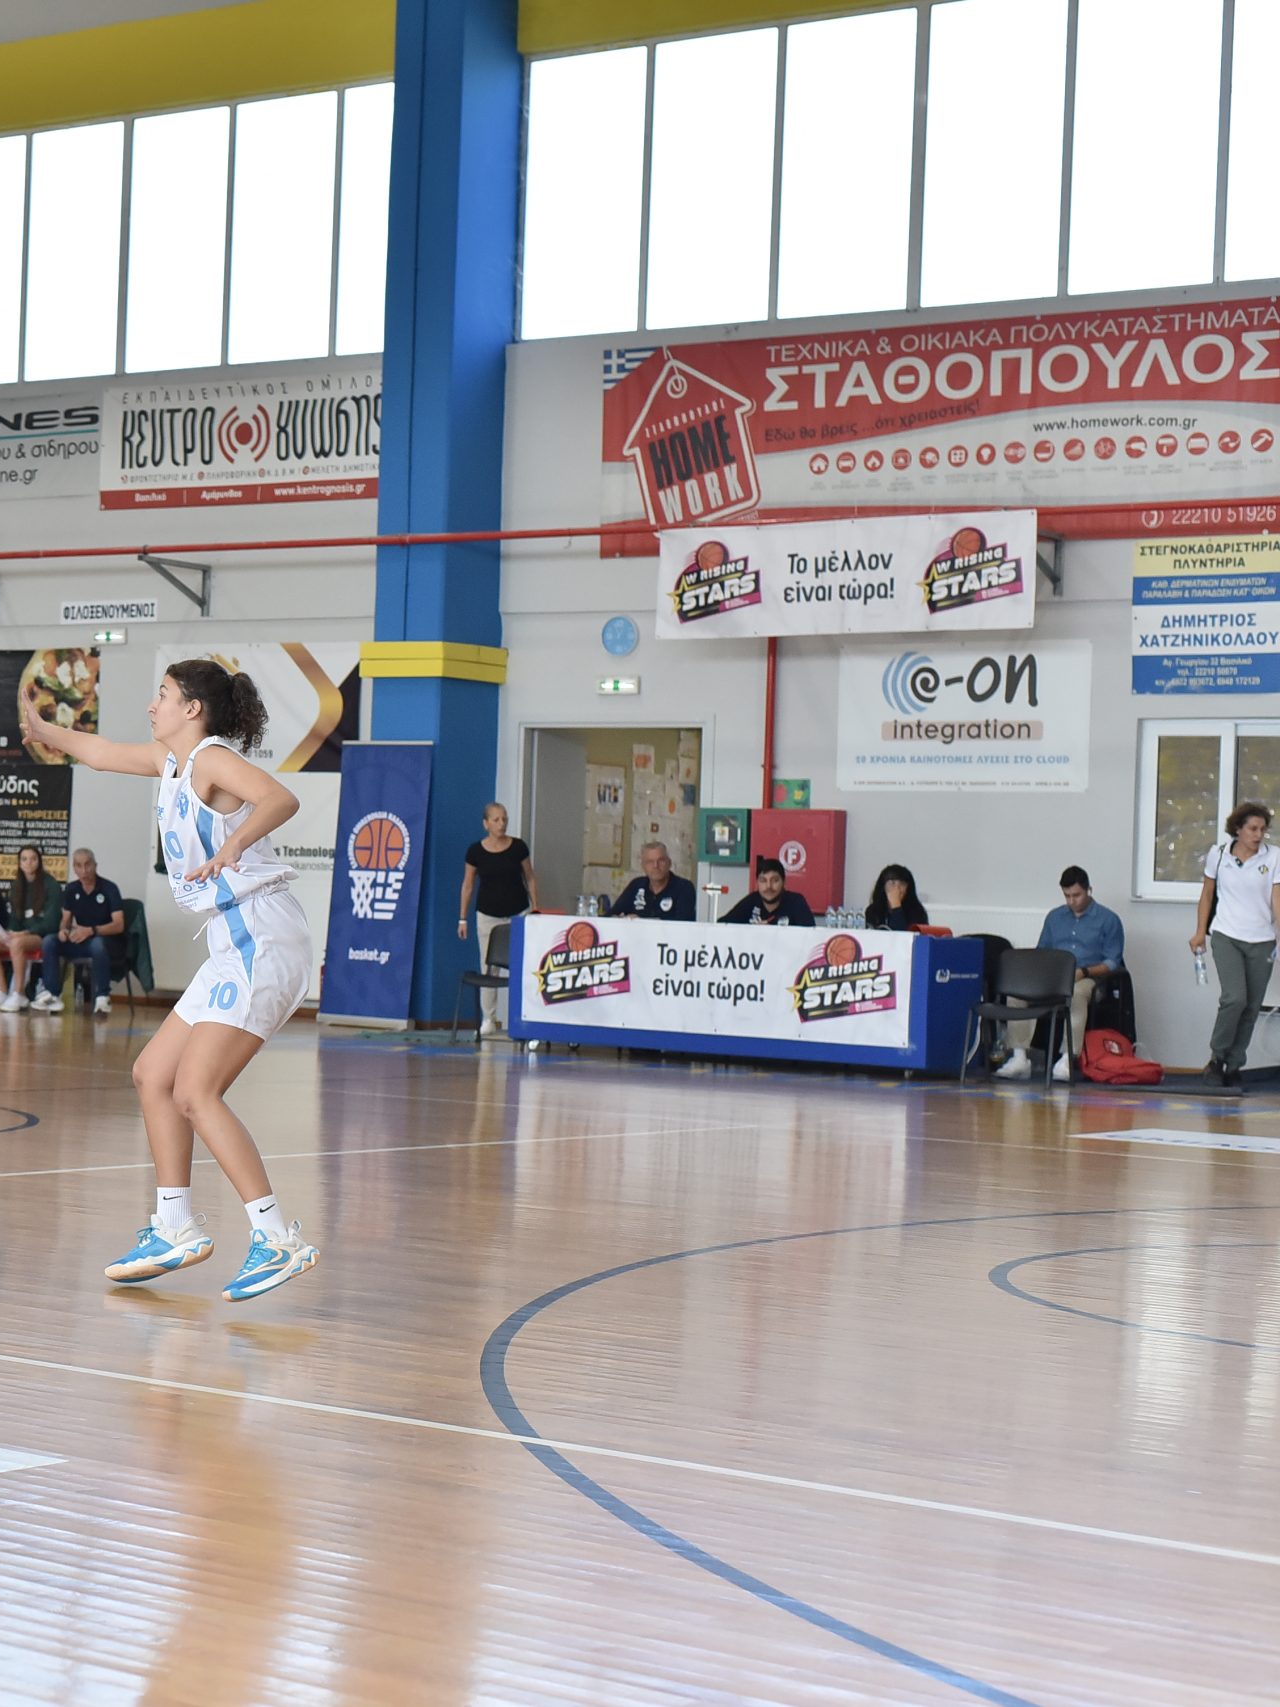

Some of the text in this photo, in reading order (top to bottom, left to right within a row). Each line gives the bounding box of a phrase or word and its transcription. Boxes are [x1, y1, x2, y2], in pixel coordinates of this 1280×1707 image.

[767, 306, 1280, 363] ΤΕΧΝΙΚΑ & ΟΙΚΙΑΚΑ ΠΟΛΥΚΑΤΑΣΤΗΜΑΤΑ
[763, 330, 1280, 412] ΣΤΑΘΟΠΟΥΛΟΣ
[122, 375, 382, 404] ΕΚΠΑΙΔΕΥΤΙΚΟΣ ΟΜΙΛΟ
[1032, 414, 1198, 433] www.homework.com.gr
[19, 443, 26, 459] &
[649, 415, 736, 490] HOME
[274, 482, 366, 496] www.kentrognosis.gr
[658, 463, 744, 524] WORK
[1172, 506, 1277, 525] 22210 51926
[1140, 541, 1280, 556] ΣΤΕΓΝΟΚΑΘΑΡΙΣΤΗΡΙΑ
[788, 550, 892, 579] Το μέλλον
[1173, 557, 1246, 570] ΠΛΥΝΤΗΡΙΑ
[682, 573, 756, 611] STARS
[784, 578, 894, 605] είναι τώρα!
[931, 561, 1016, 601] STARS
[63, 602, 156, 620] ΦΙΛΟΞΕΝΟΥΜΕΝΟΙ
[1161, 613, 1256, 628] ΔΗΜΗΤΡΙΟΣ
[1139, 632, 1279, 648] ΧΑΤΖΗΝΙΚΟΛΑΟΥ
[893, 719, 1031, 745] integration
[1037, 755, 1070, 764] CLOUD
[787, 848, 798, 864] F
[348, 947, 390, 965] basket.gr
[552, 945, 614, 965] W RISING
[657, 944, 764, 971] Το μέλλον
[546, 960, 625, 993] STARS
[809, 959, 879, 980] W RISING
[208, 981, 238, 1011] 10
[652, 974, 765, 1007] είναι τώρα!
[803, 975, 890, 1009] STARS
